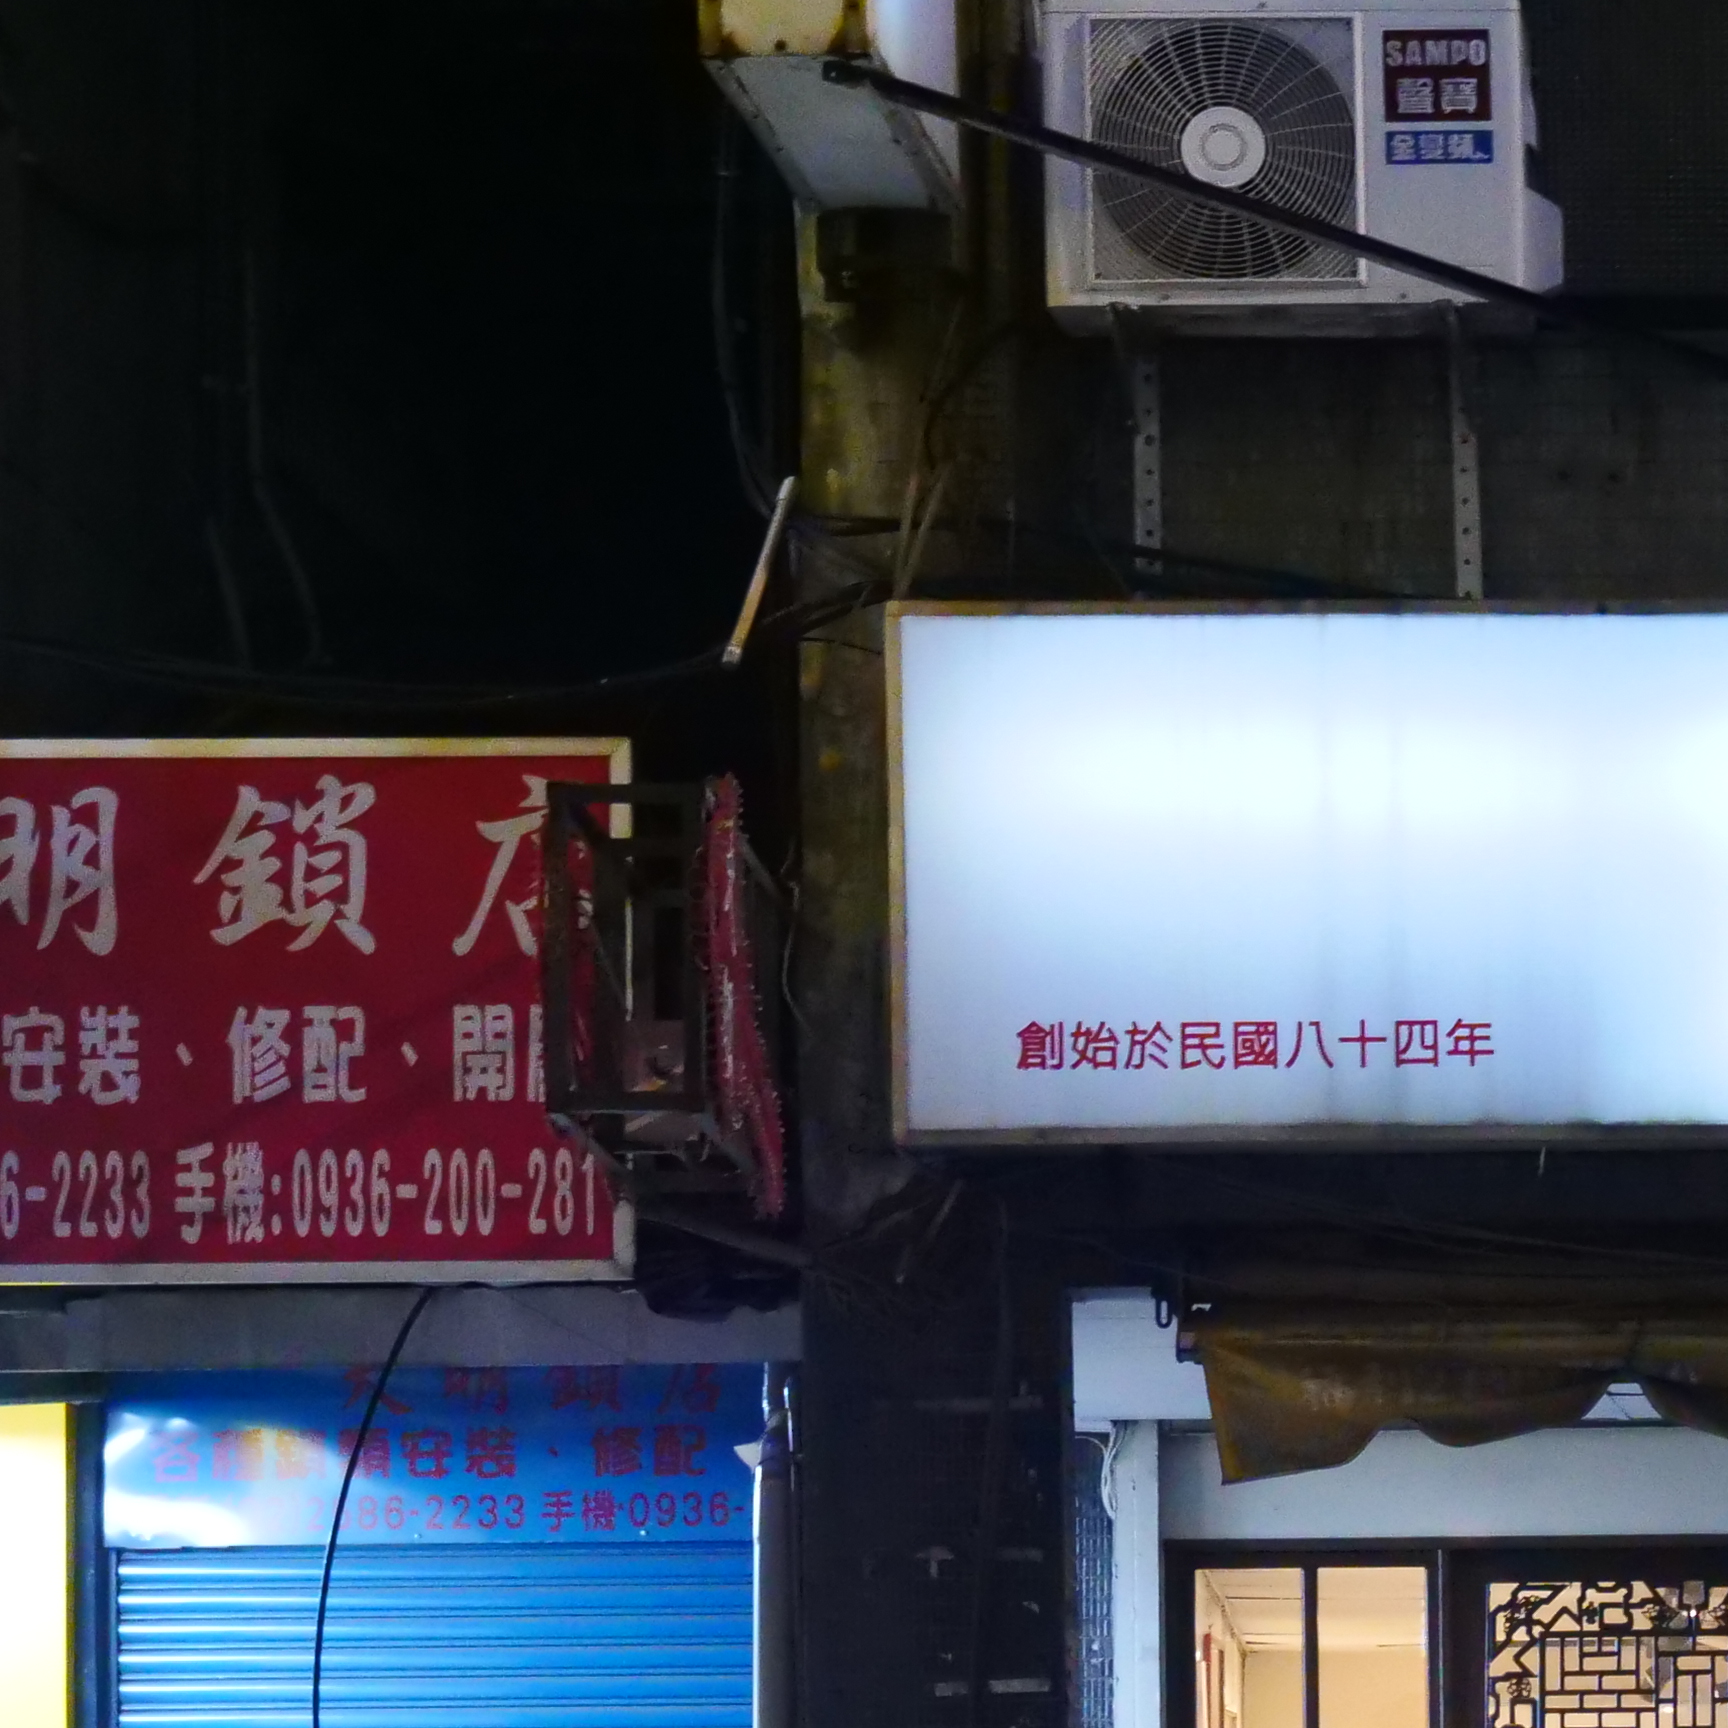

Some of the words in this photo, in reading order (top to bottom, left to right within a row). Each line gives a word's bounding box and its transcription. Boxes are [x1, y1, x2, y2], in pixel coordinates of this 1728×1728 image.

[1385, 38, 1487, 67] SAMPO
[1015, 1019, 1495, 1070] 創始於民國八十四年
